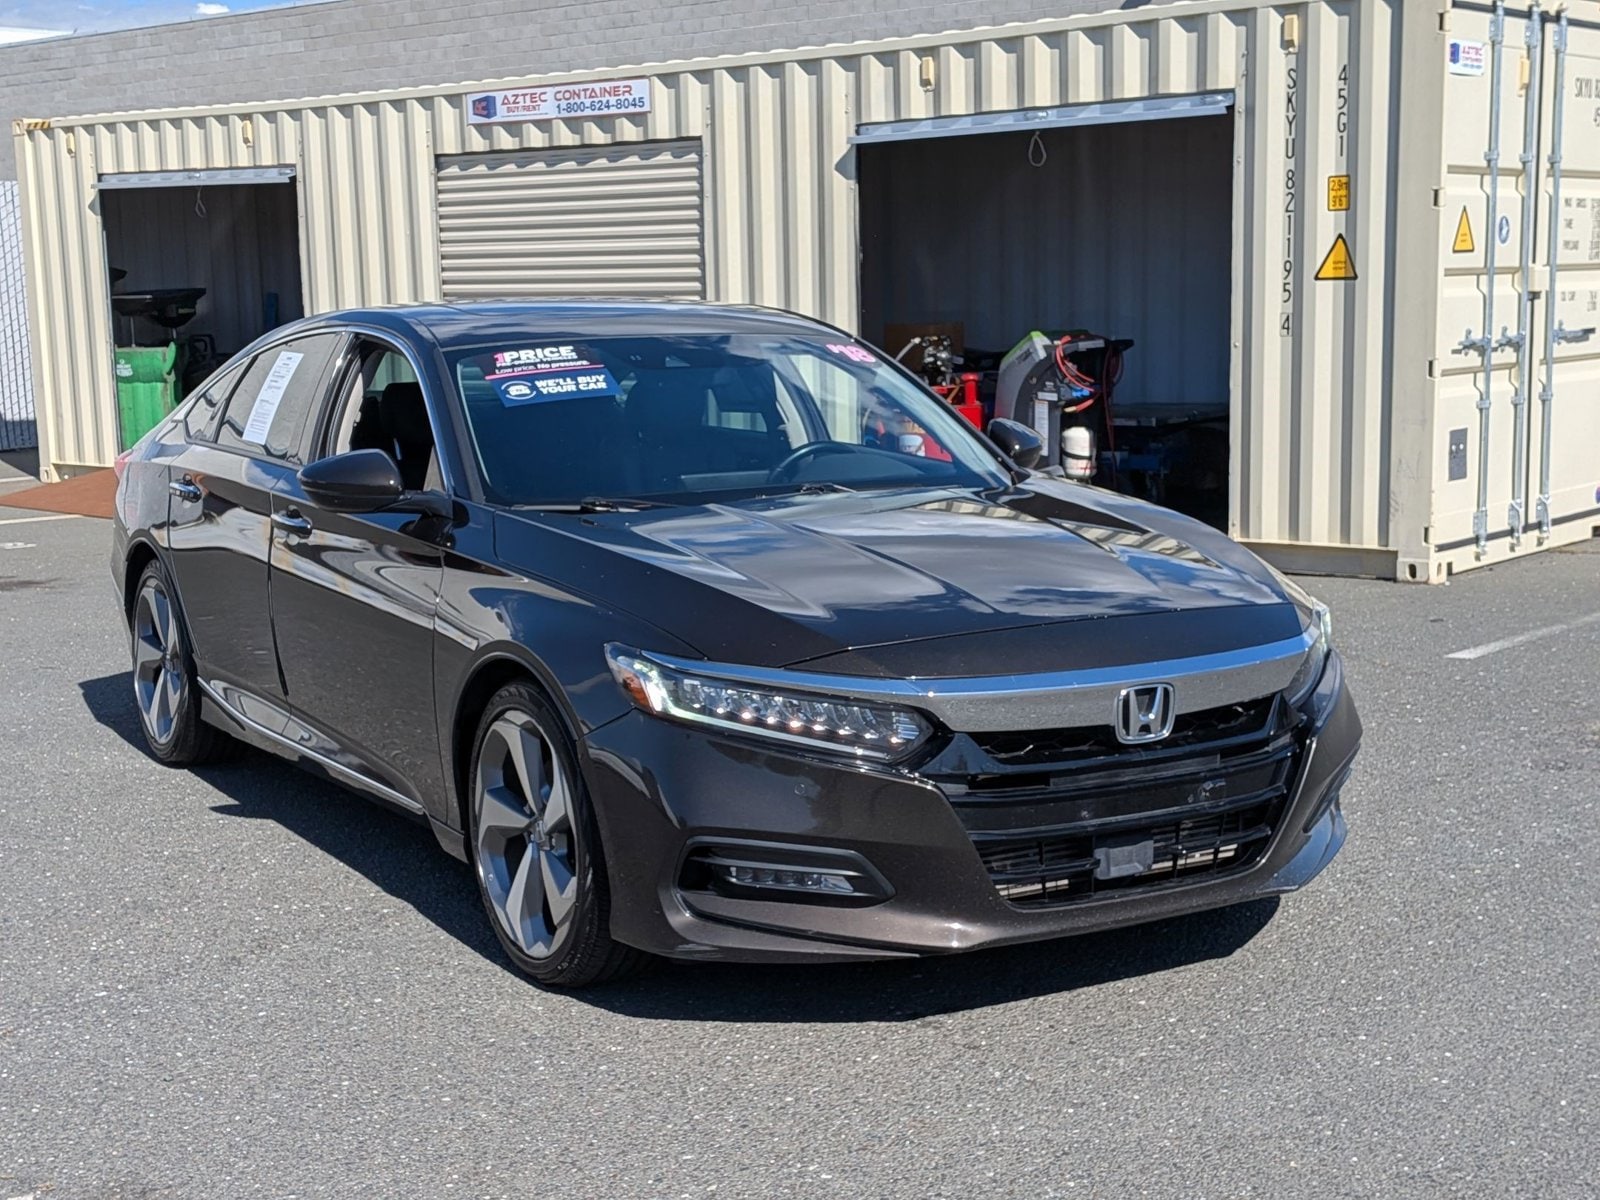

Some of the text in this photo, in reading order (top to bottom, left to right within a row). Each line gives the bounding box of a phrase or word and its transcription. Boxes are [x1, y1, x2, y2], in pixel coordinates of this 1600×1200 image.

[501, 85, 632, 106] AZTEC CONTAINER
[556, 97, 645, 115] 1-800-624-8045
[1286, 68, 1297, 160] SKYU
[1337, 64, 1348, 157] 45G1
[1283, 168, 1296, 304] 821195
[551, 360, 590, 369] pressure.
[534, 375, 606, 388] WE'LL BUY
[539, 382, 608, 395] YOUR CAR
